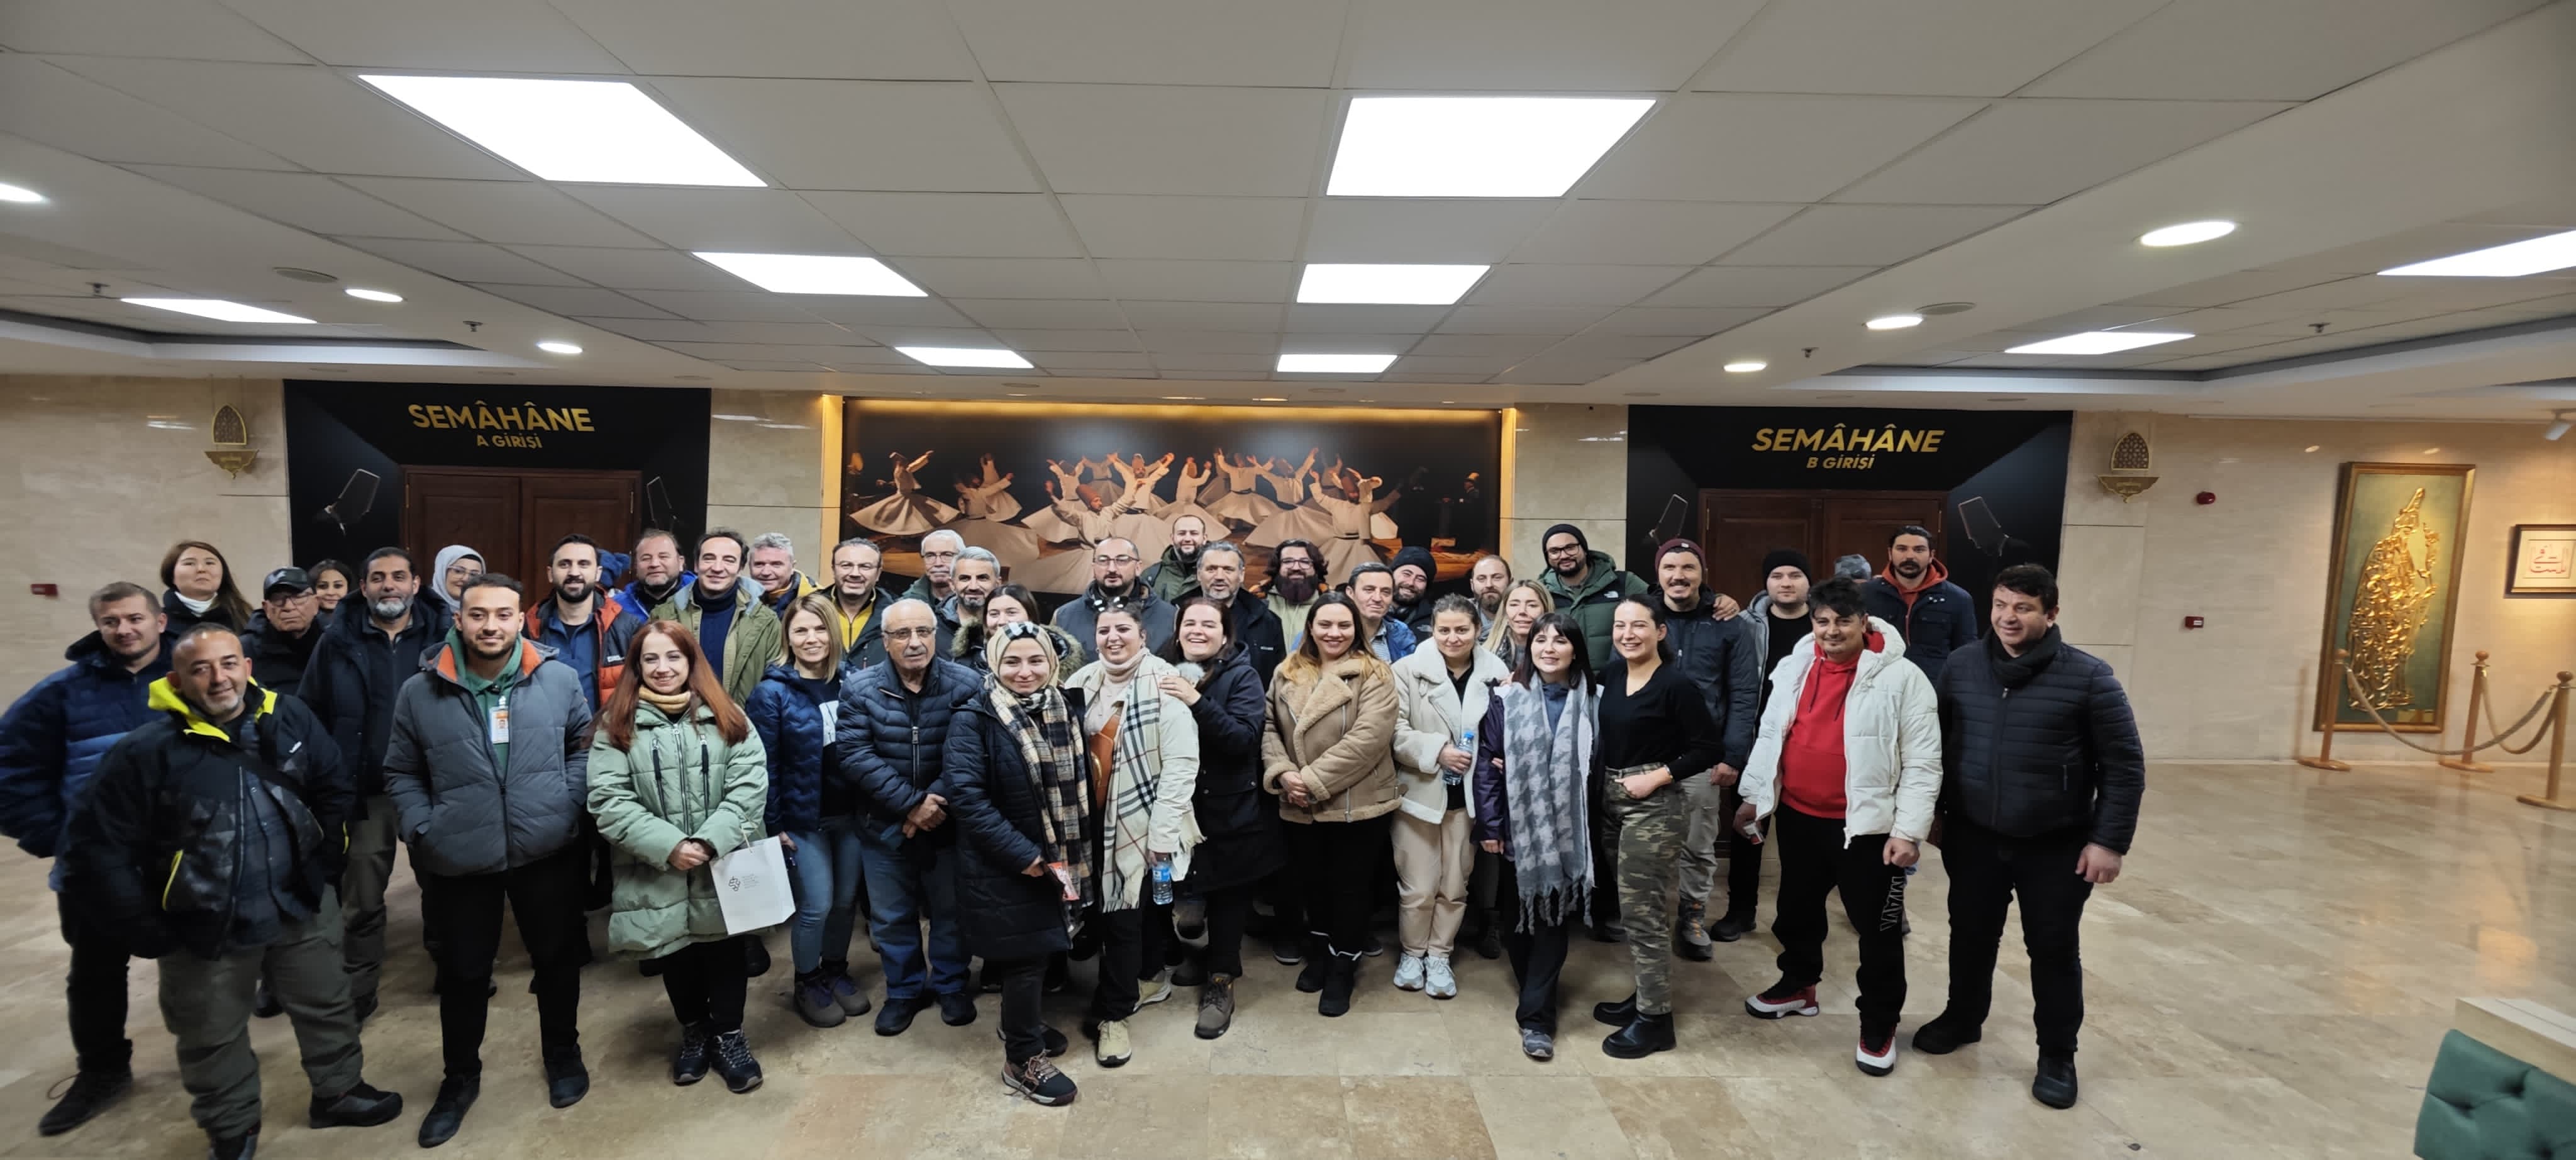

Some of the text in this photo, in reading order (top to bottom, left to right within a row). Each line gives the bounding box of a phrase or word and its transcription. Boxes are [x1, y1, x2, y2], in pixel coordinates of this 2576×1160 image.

[408, 399, 595, 432] SEMÂHÂNE
[477, 434, 489, 447] A
[1752, 423, 1945, 452] SEMÂHÂNE
[1806, 457, 1819, 469] B
